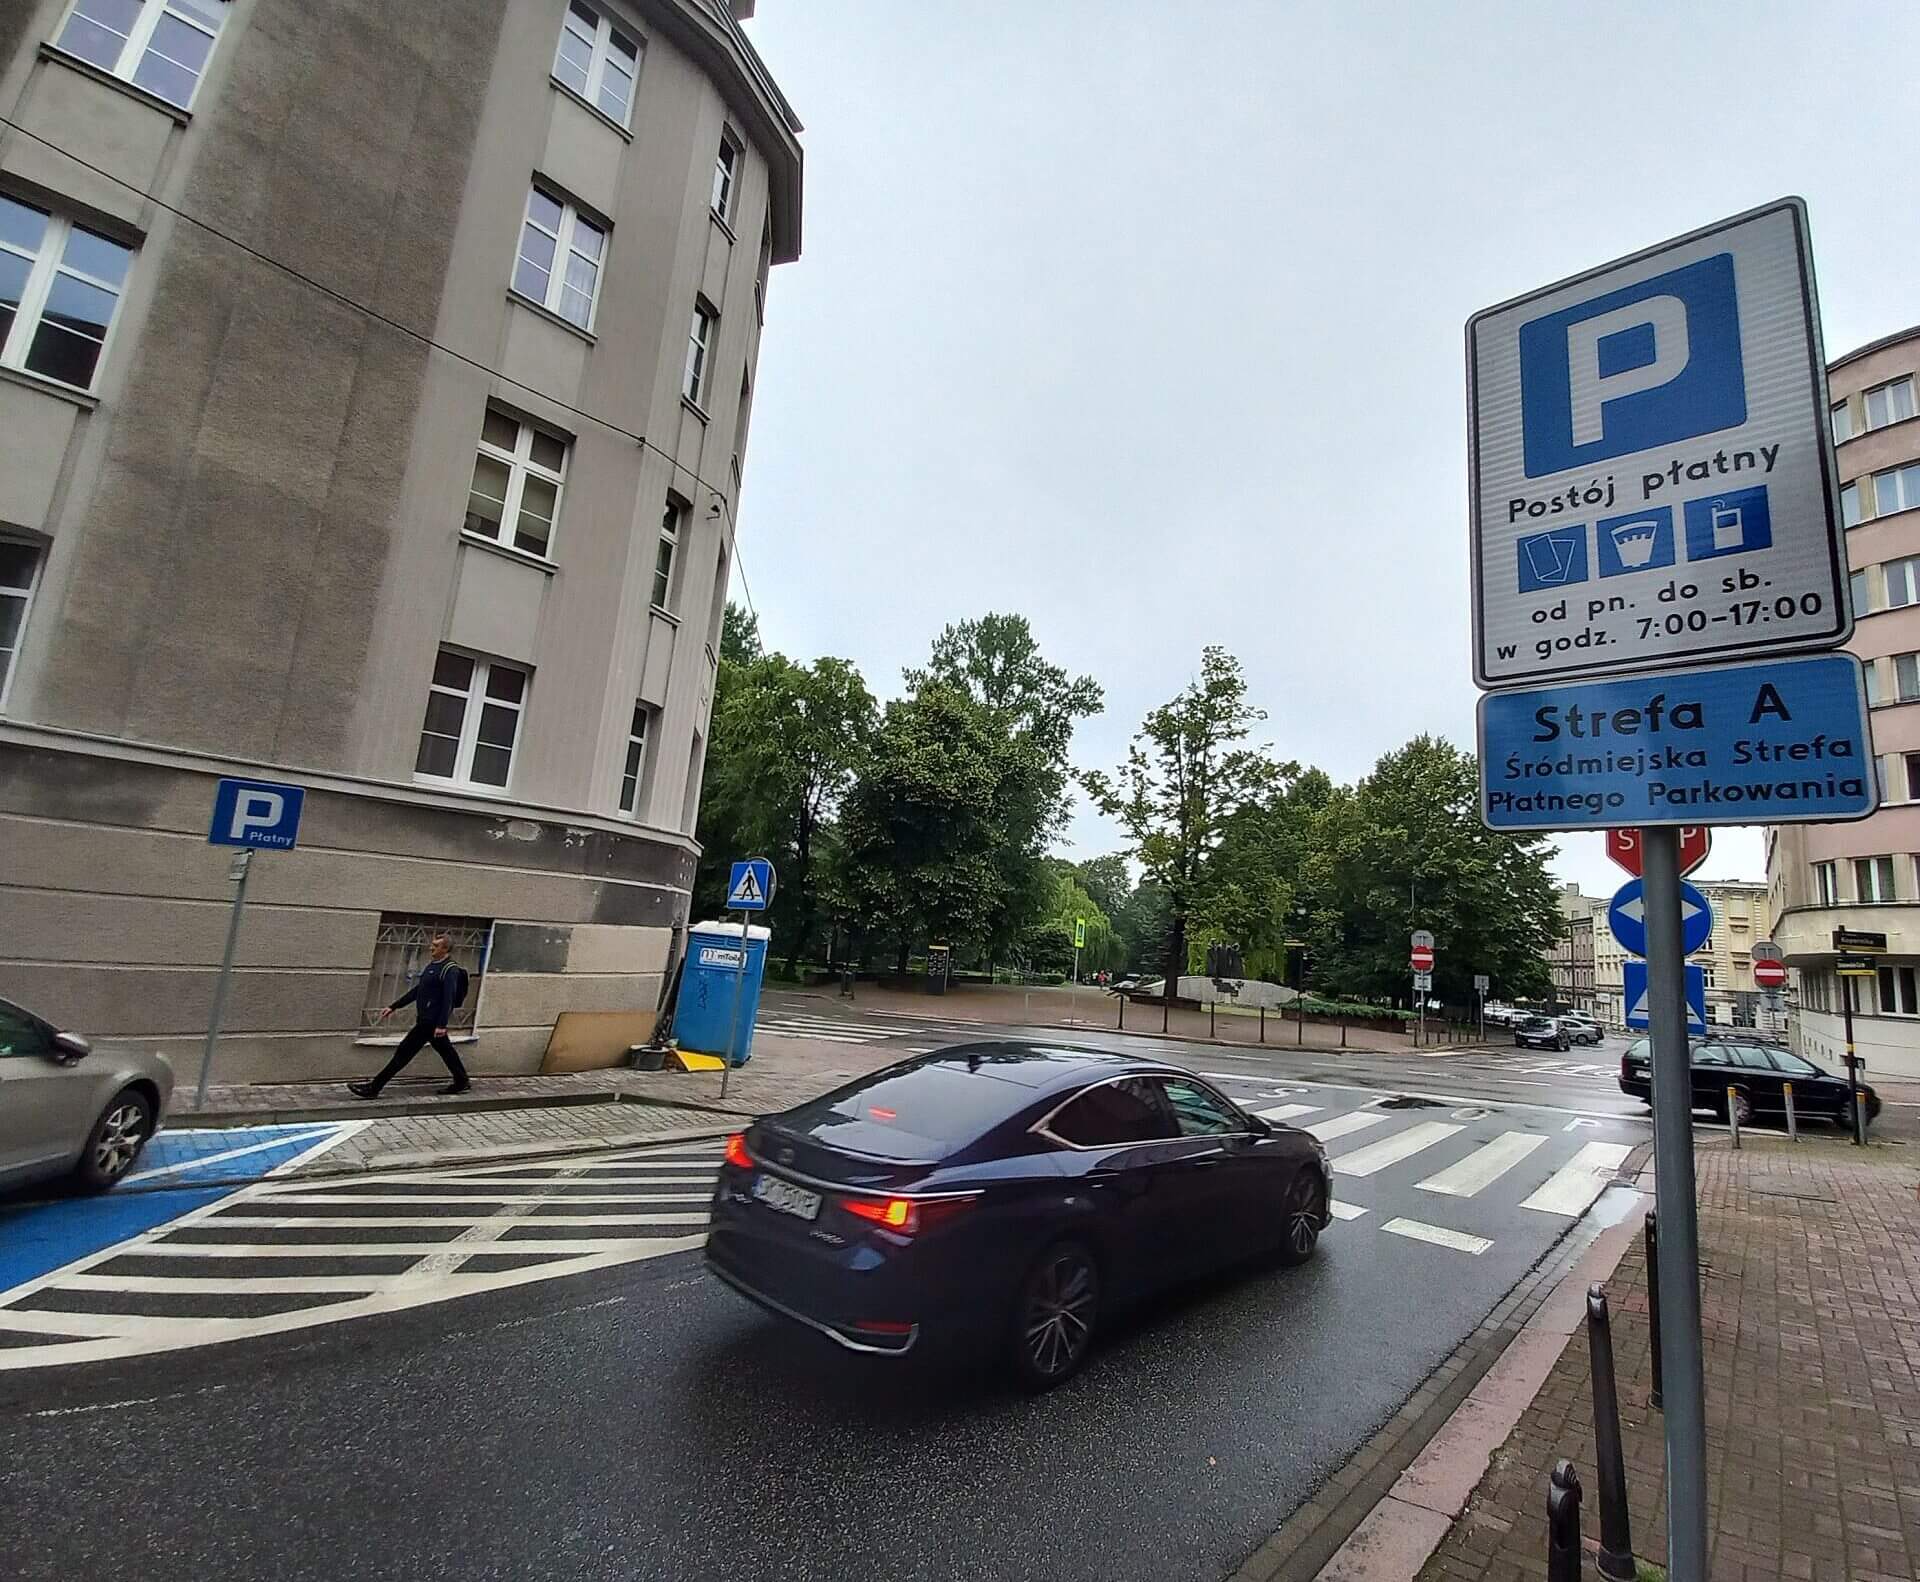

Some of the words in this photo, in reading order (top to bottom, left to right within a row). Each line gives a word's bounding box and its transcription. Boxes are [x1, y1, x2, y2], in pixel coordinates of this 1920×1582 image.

[1568, 294, 1690, 448] P
[1508, 476, 1615, 523] Postój
[1642, 444, 1780, 499] płatny
[1532, 600, 1567, 623] od
[1588, 594, 1635, 621] pn.
[1657, 581, 1698, 602] do
[1722, 568, 1772, 593] sb.
[1496, 643, 1517, 660] w
[1535, 627, 1617, 660] godz.
[1636, 592, 1822, 640] 7:00-17:00
[1533, 694, 1704, 743] Strefa
[1748, 683, 1792, 724] A
[1504, 746, 1707, 780] Śródmiejska
[1732, 734, 1853, 766] Strefa
[230, 789, 284, 839] P
[1487, 790, 1625, 815] Płatnego
[1647, 772, 1864, 806] Parkowania
[250, 831, 293, 846] Płatny
[1617, 828, 1697, 851] SP
